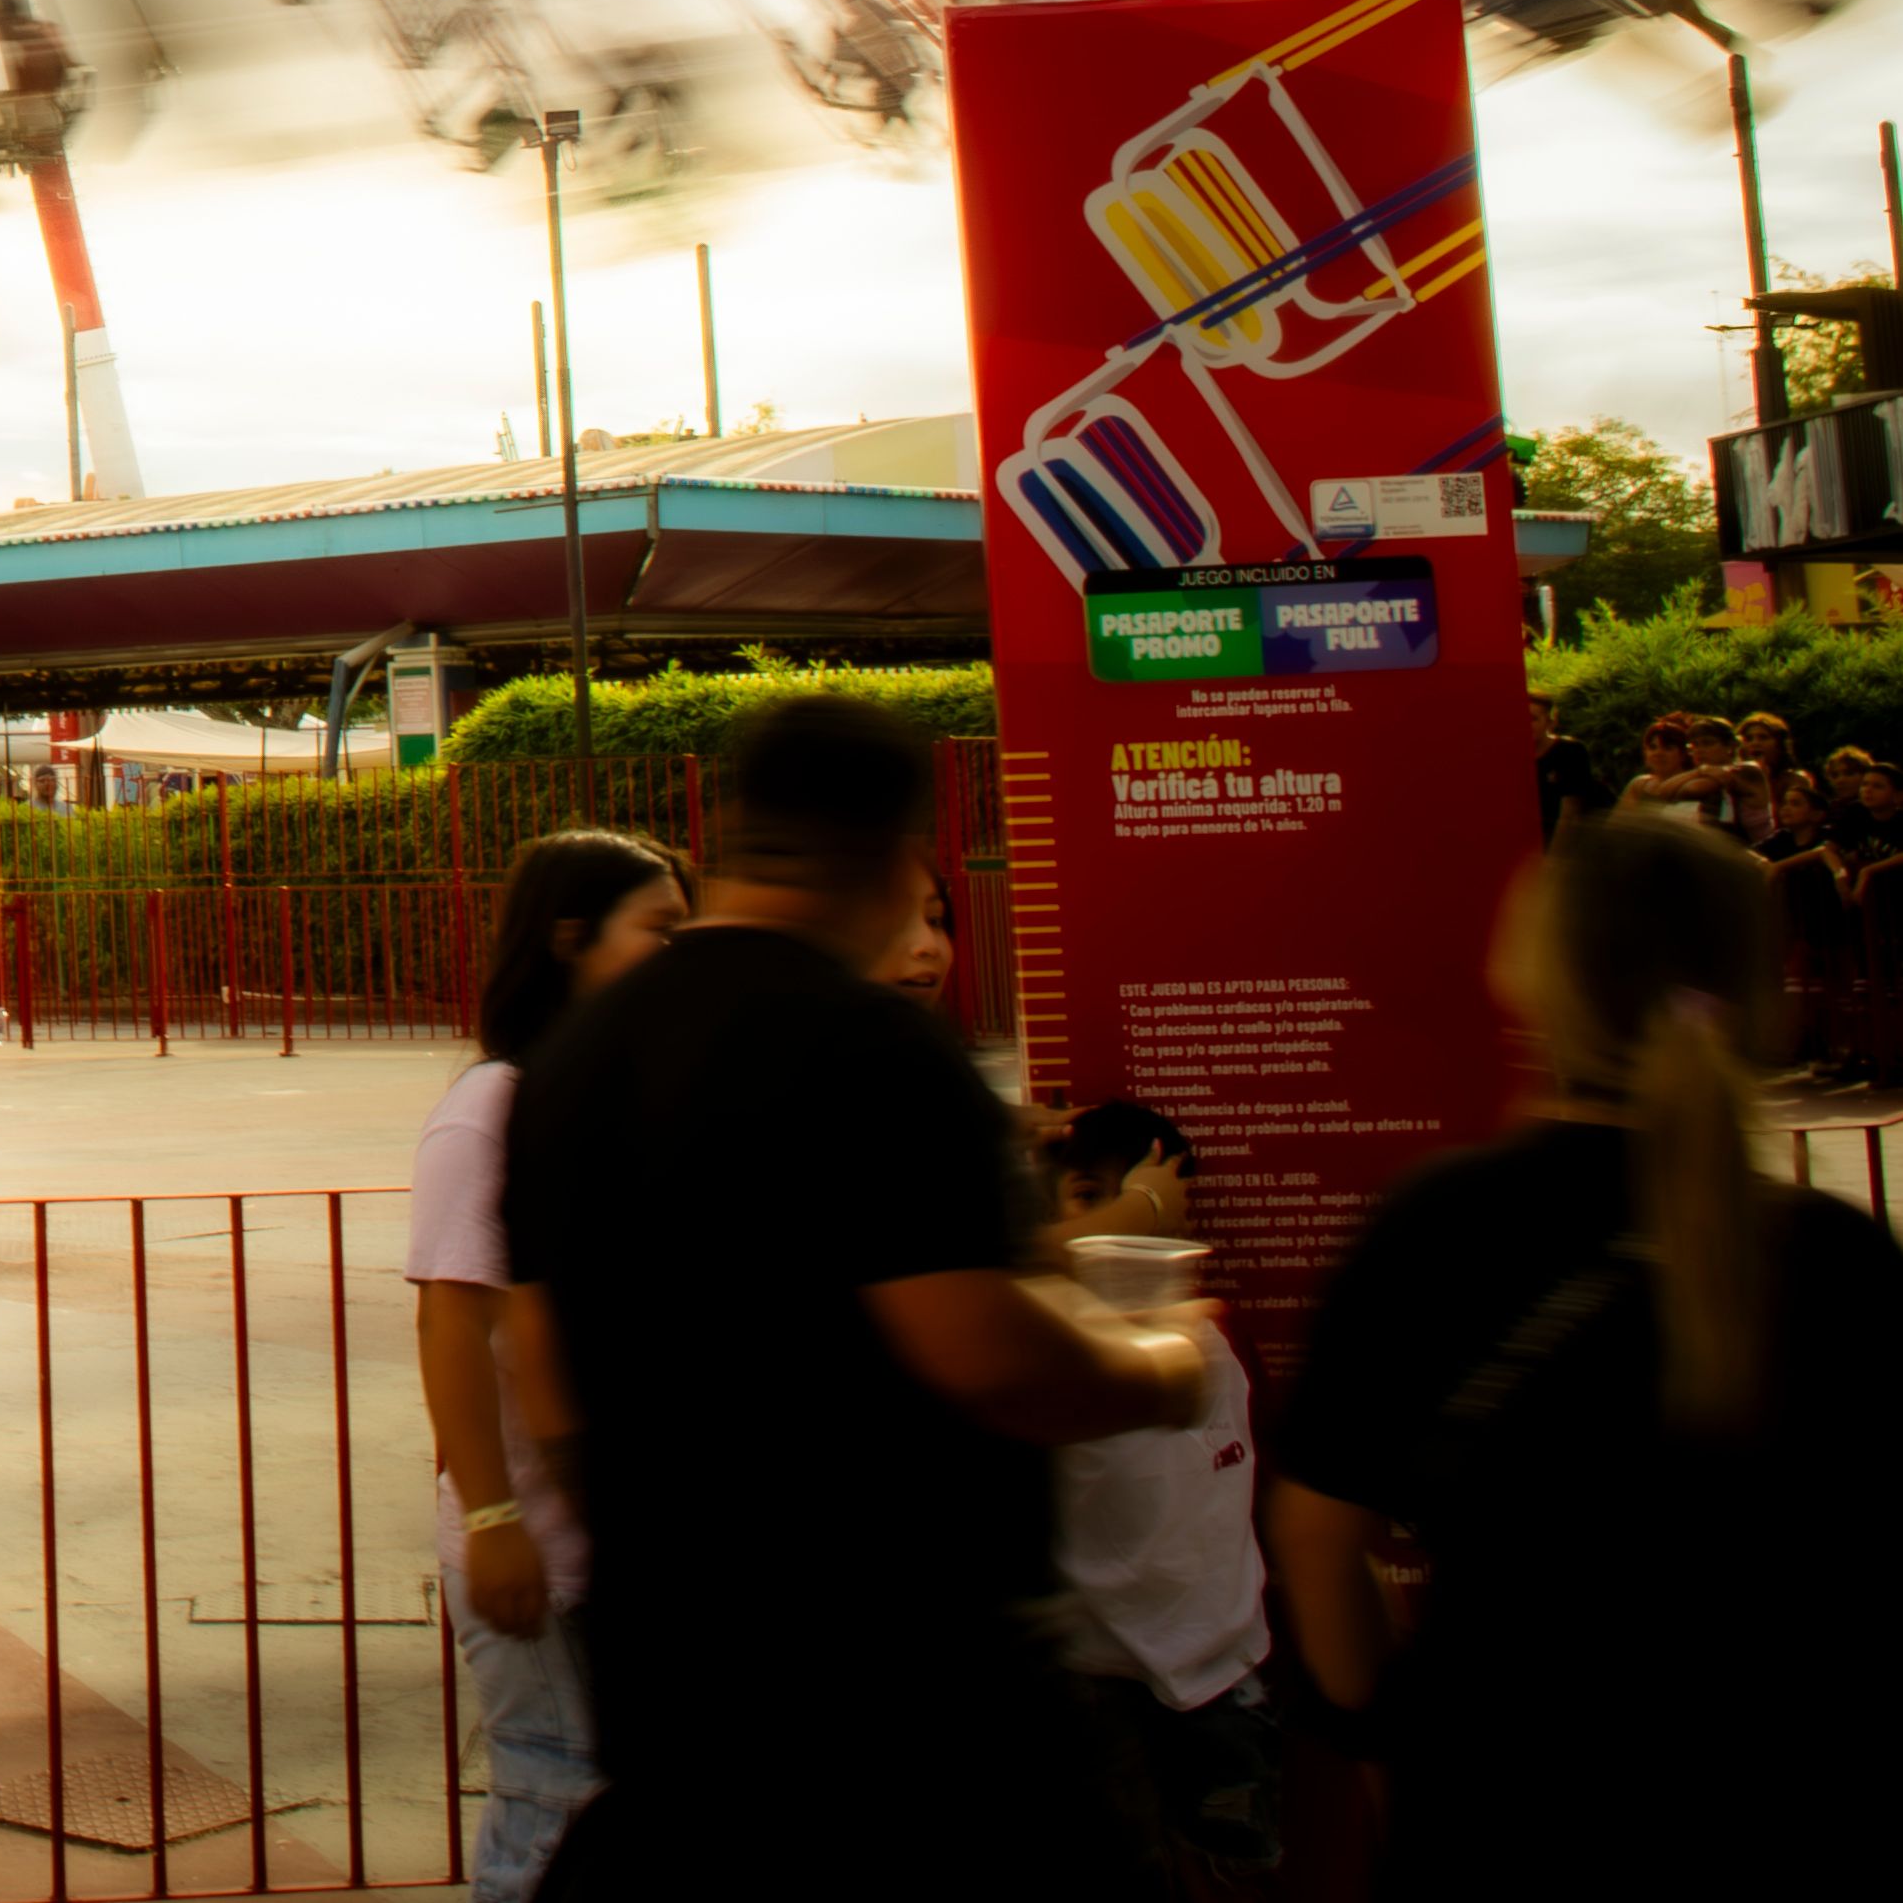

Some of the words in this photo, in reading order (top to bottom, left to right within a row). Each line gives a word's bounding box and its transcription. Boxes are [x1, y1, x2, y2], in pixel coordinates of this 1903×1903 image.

[1179, 570, 1231, 586] JUEGO
[1235, 567, 1309, 583] INCLUIDO
[1313, 565, 1335, 580] EN
[1100, 608, 1243, 637] PASAPORTE
[1276, 599, 1420, 628] PASAPORTE
[1132, 634, 1222, 660] PROMO
[1325, 627, 1380, 650] FULL
[1192, 689, 1208, 703] No
[1210, 690, 1224, 702] se
[1226, 687, 1269, 706] pueden
[1271, 687, 1321, 700] reservar
[1176, 704, 1251, 718] intercambiar
[1254, 701, 1297, 717] lugares
[1299, 701, 1314, 712] en
[1316, 700, 1328, 712] la
[1330, 698, 1352, 712] fila.
[1111, 734, 1252, 771] ATENCIÓN:
[1112, 770, 1219, 801] Verificá
[1224, 772, 1254, 797] tu
[1259, 769, 1342, 796] altura
[1114, 804, 1158, 819] Altura
[1161, 801, 1214, 817] mínima
[1217, 798, 1292, 817] requerida:
[1295, 797, 1324, 813] 1.20
[1328, 799, 1342, 811] m
[1115, 824, 1131, 837] No
[1133, 824, 1158, 838] apto
[1161, 823, 1188, 838] para
[1191, 821, 1241, 835] menores
[1243, 819, 1258, 832] de
[1261, 819, 1274, 831] 14
[1119, 984, 1147, 997] ESTE
[1150, 982, 1185, 997] JUEGO
[1188, 982, 1205, 995] NO
[1207, 981, 1222, 995] ES
[1224, 980, 1253, 995] APTO
[1255, 979, 1286, 993] PARA
[1288, 977, 1350, 992] PERSONAS:
[1129, 1004, 1152, 1017] Con
[1154, 1002, 1214, 1018] problemas
[1131, 1023, 1154, 1037] Con
[1220, 1021, 1235, 1034] de
[1133, 1044, 1155, 1058] Con
